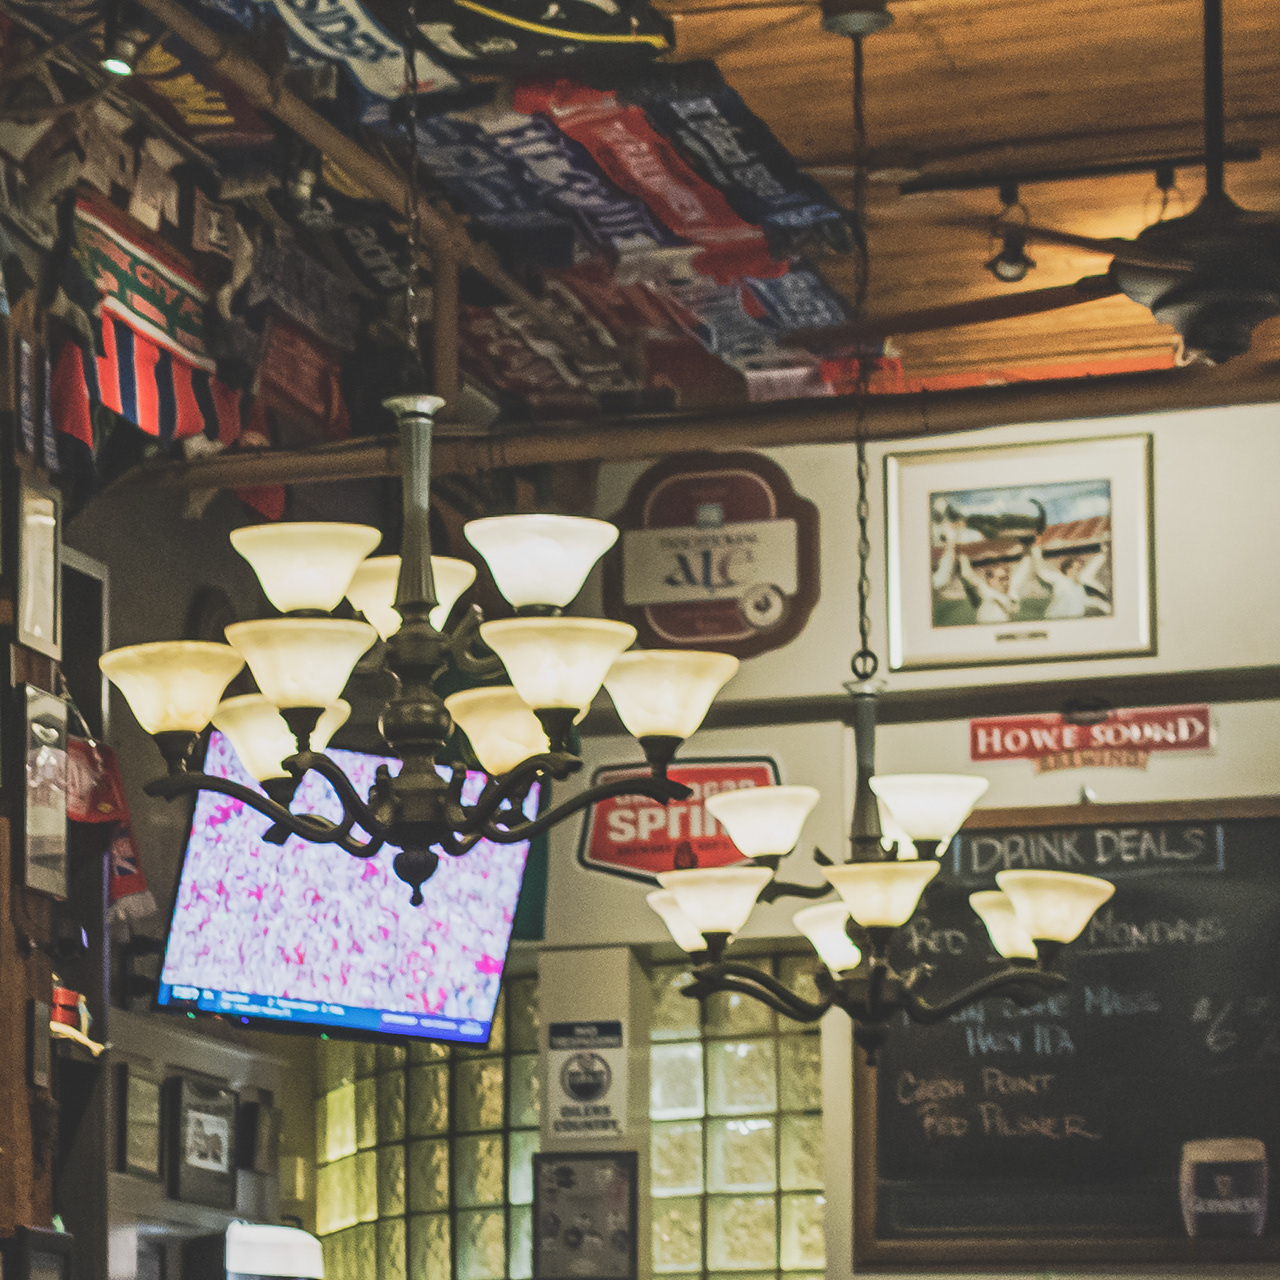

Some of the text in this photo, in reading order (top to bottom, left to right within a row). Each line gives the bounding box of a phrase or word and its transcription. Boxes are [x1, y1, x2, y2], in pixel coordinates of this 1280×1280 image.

[975, 716, 1206, 755] HOWE SOUND
[970, 828, 1206, 874] DRINK DEALS
